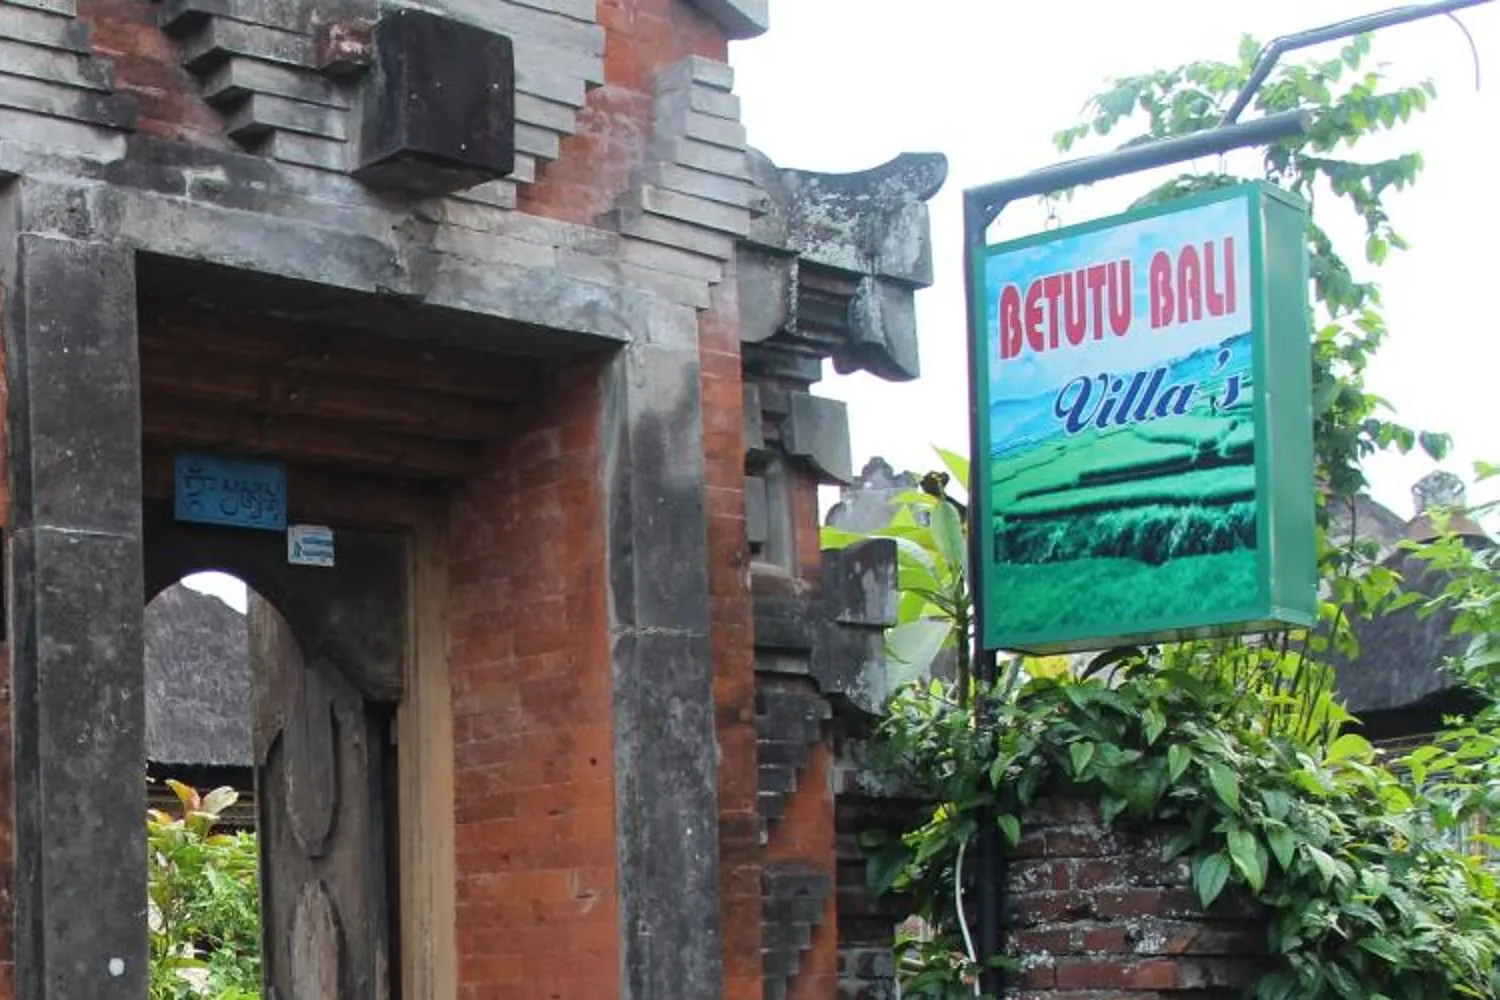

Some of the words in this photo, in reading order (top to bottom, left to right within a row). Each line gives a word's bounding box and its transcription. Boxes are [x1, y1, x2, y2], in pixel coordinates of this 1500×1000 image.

[1000, 259, 1132, 360] BETUTU
[1149, 236, 1237, 329] BALI
[1054, 350, 1241, 434] Villa's
